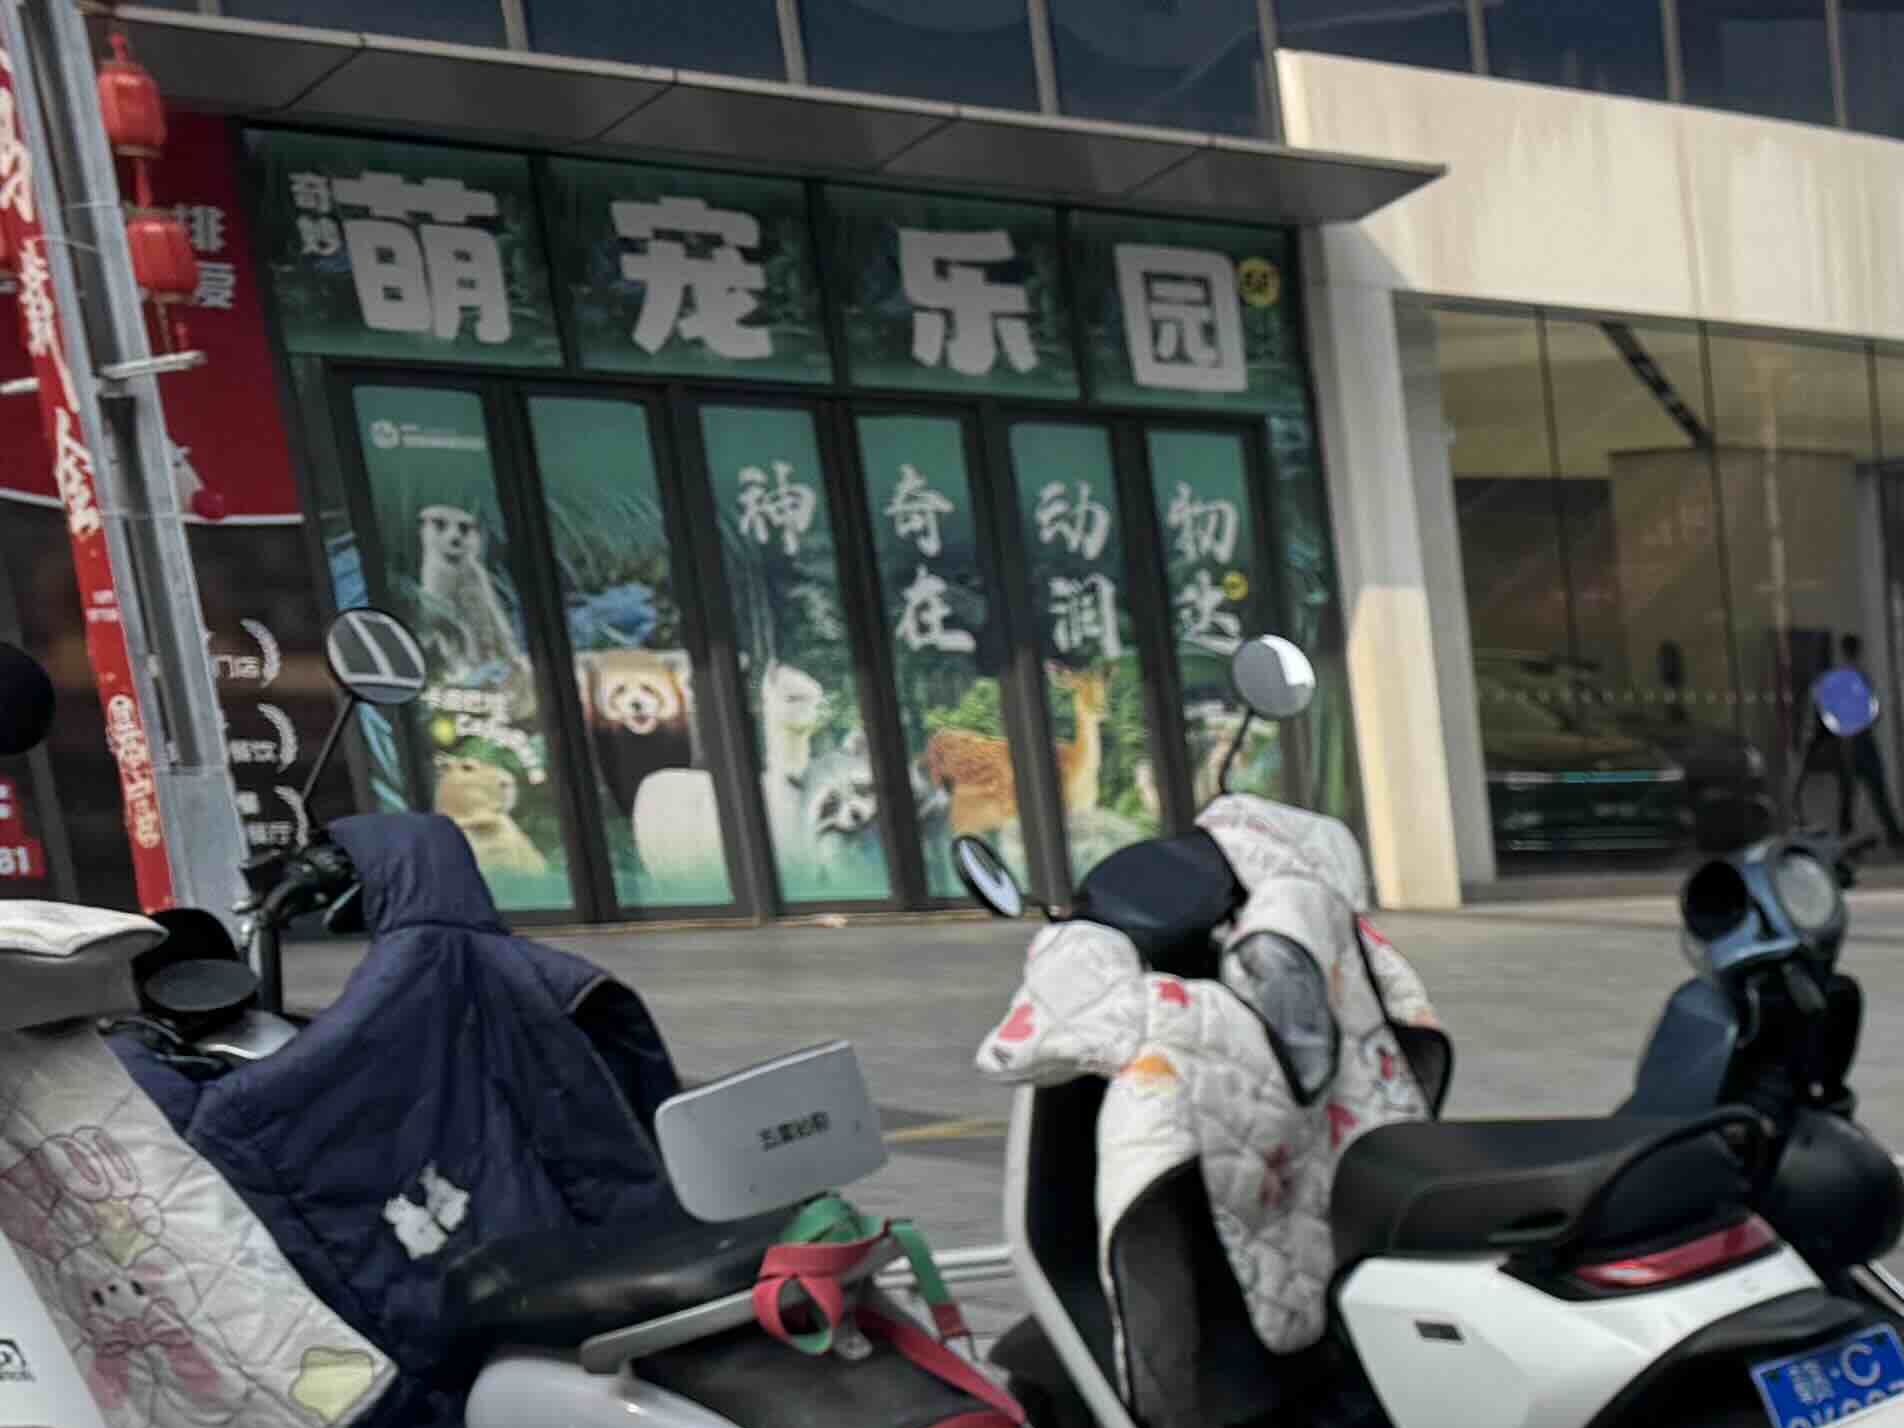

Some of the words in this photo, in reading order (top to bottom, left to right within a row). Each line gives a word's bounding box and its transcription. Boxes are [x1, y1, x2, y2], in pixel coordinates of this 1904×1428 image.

[288, 172, 341, 255] 奇妙
[329, 170, 1249, 392] 萌宠乐园
[738, 460, 1238, 563] 神奇动物
